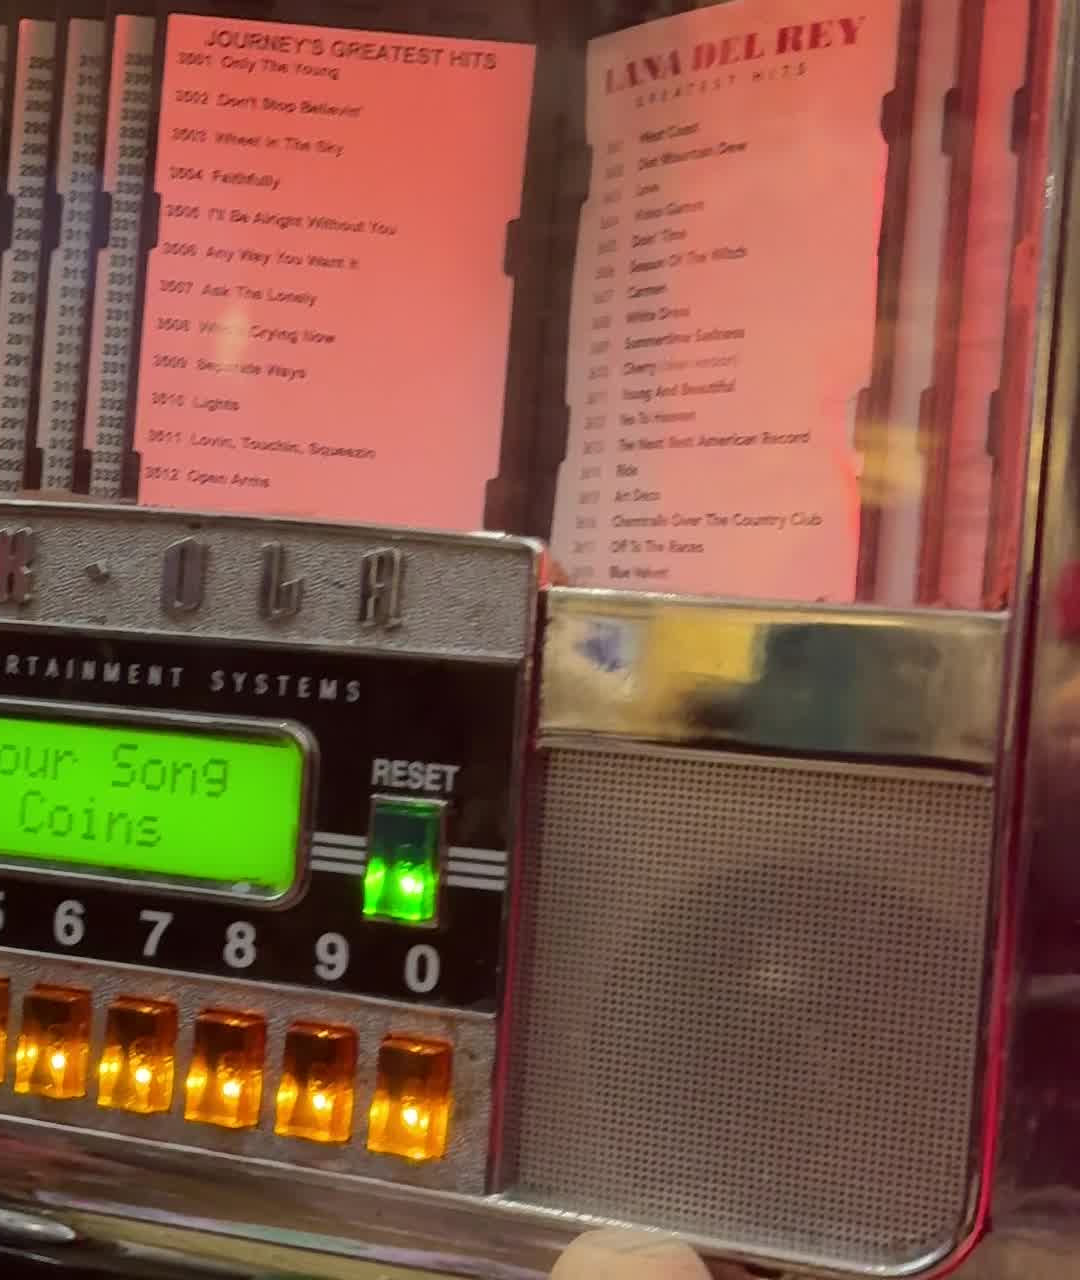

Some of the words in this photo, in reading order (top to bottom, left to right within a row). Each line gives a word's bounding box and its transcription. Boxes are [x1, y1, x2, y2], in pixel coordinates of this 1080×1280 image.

[204, 29, 324, 57] JOURNEY'S
[331, 38, 444, 66] GREATEST
[449, 52, 497, 71] HITS
[604, 48, 682, 96] LANA
[691, 31, 765, 71] DEL
[775, 15, 867, 55] REY
[220, 55, 257, 73] Only
[261, 58, 289, 74] The
[294, 63, 341, 81] Young
[283, 136, 312, 151] The
[314, 140, 345, 158] Sky
[211, 170, 281, 191] Faithfully
[229, 209, 249, 224] Be
[306, 215, 365, 233] Without
[368, 221, 398, 236] You
[205, 245, 235, 263] Any
[238, 247, 273, 266] Way
[275, 251, 305, 266] You
[201, 282, 231, 297] Ask
[234, 285, 263, 301] The
[267, 287, 319, 307] Lonely
[249, 324, 299, 344] Crying
[302, 329, 336, 344] Now
[192, 396, 241, 413] Lights
[185, 468, 228, 486] Open
[230, 472, 272, 490] Arms
[209, 669, 361, 704] SYSTEMS
[110, 742, 231, 799] Song
[370, 757, 462, 793] RESET
[18, 789, 163, 850] Coins
[52, 899, 87, 947] 6
[137, 908, 173, 958] 7
[223, 920, 258, 969] 8
[314, 931, 351, 982] 9
[404, 943, 441, 995] 0
